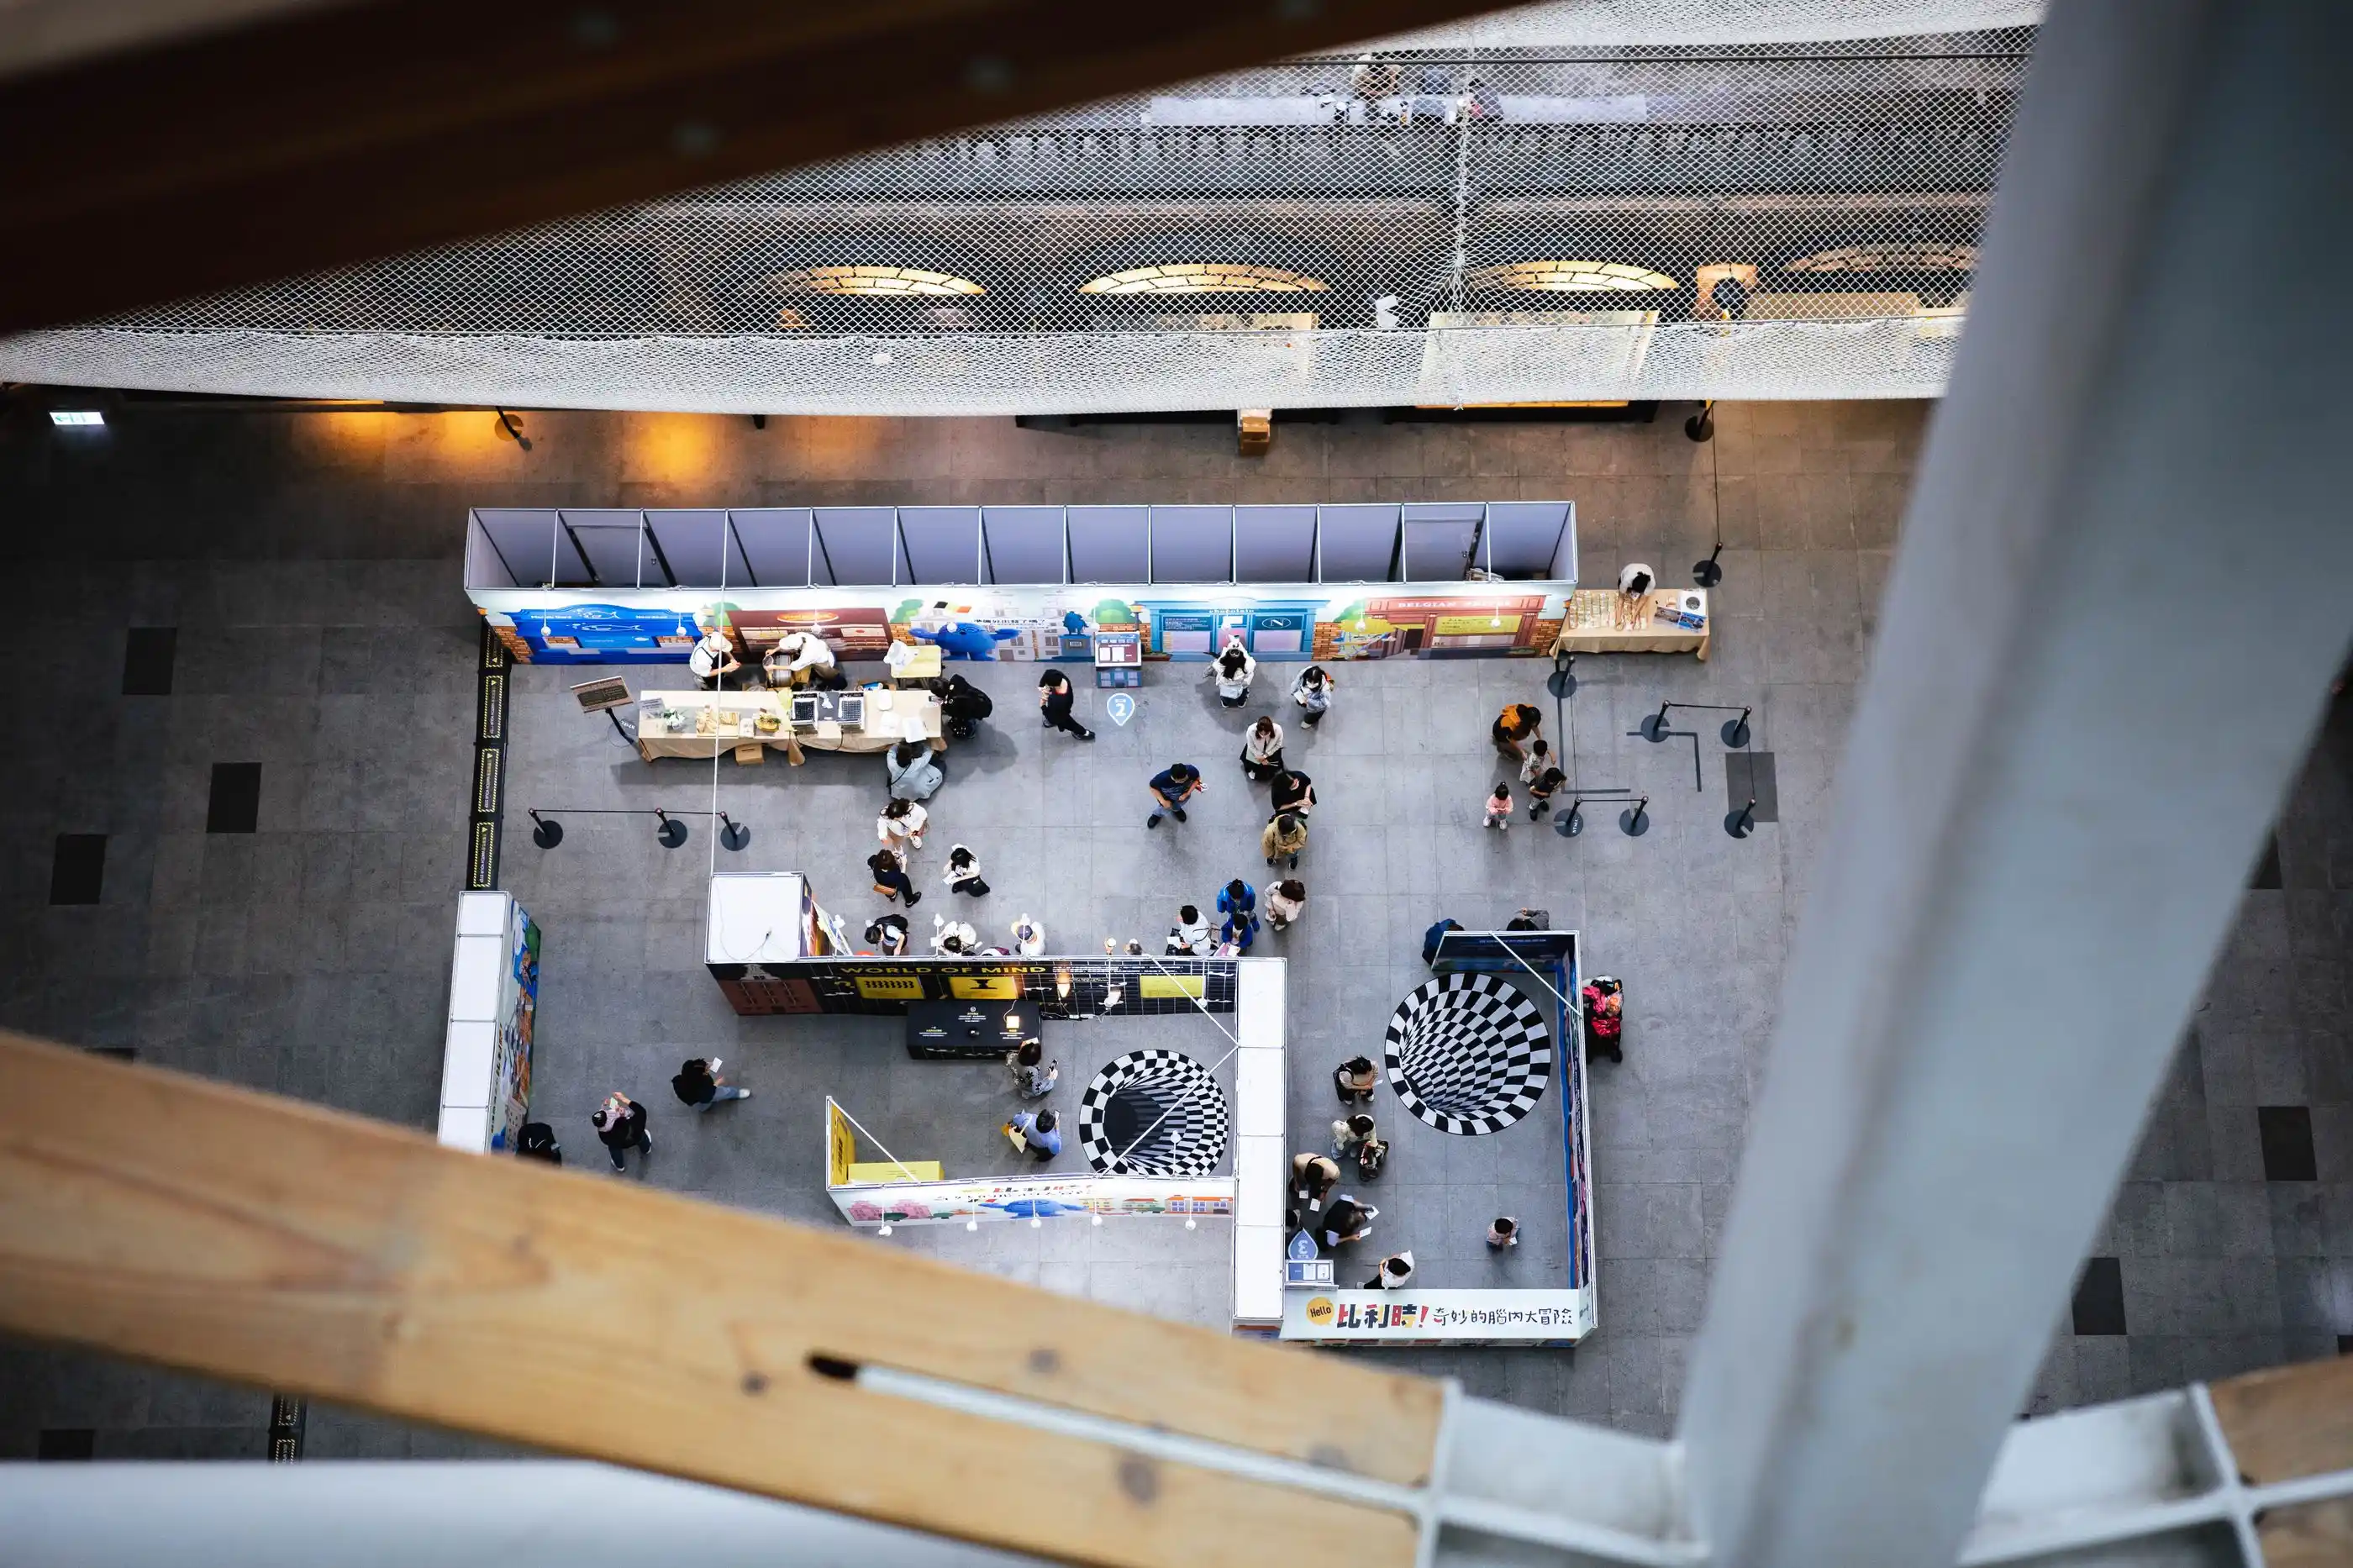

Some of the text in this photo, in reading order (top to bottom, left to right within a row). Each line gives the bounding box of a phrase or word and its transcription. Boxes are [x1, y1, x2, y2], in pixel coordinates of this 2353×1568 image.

[1115, 702, 1127, 717] 2
[1298, 1239, 1308, 1254] 3
[1309, 1303, 1573, 1329] Hello 比利時! 奇妙的腦內大冒險
